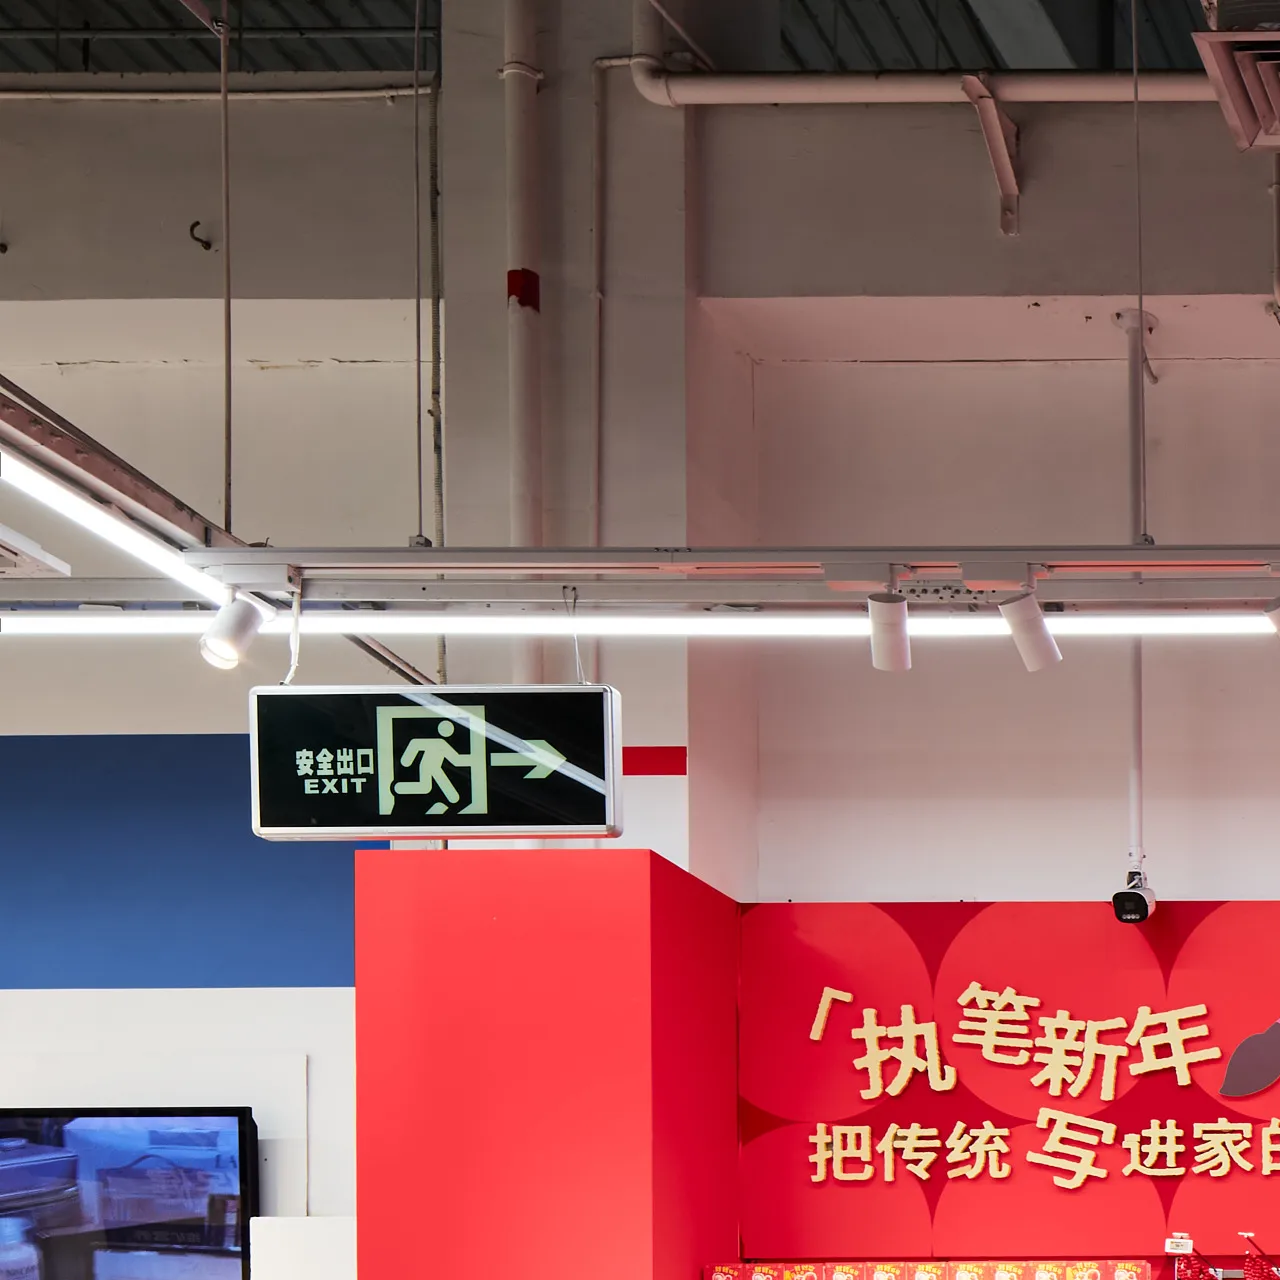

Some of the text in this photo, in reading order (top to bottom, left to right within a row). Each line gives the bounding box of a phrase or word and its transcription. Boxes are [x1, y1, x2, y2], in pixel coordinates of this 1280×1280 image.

[295, 748, 374, 776] 安全出口
[304, 777, 367, 794] EXIT
